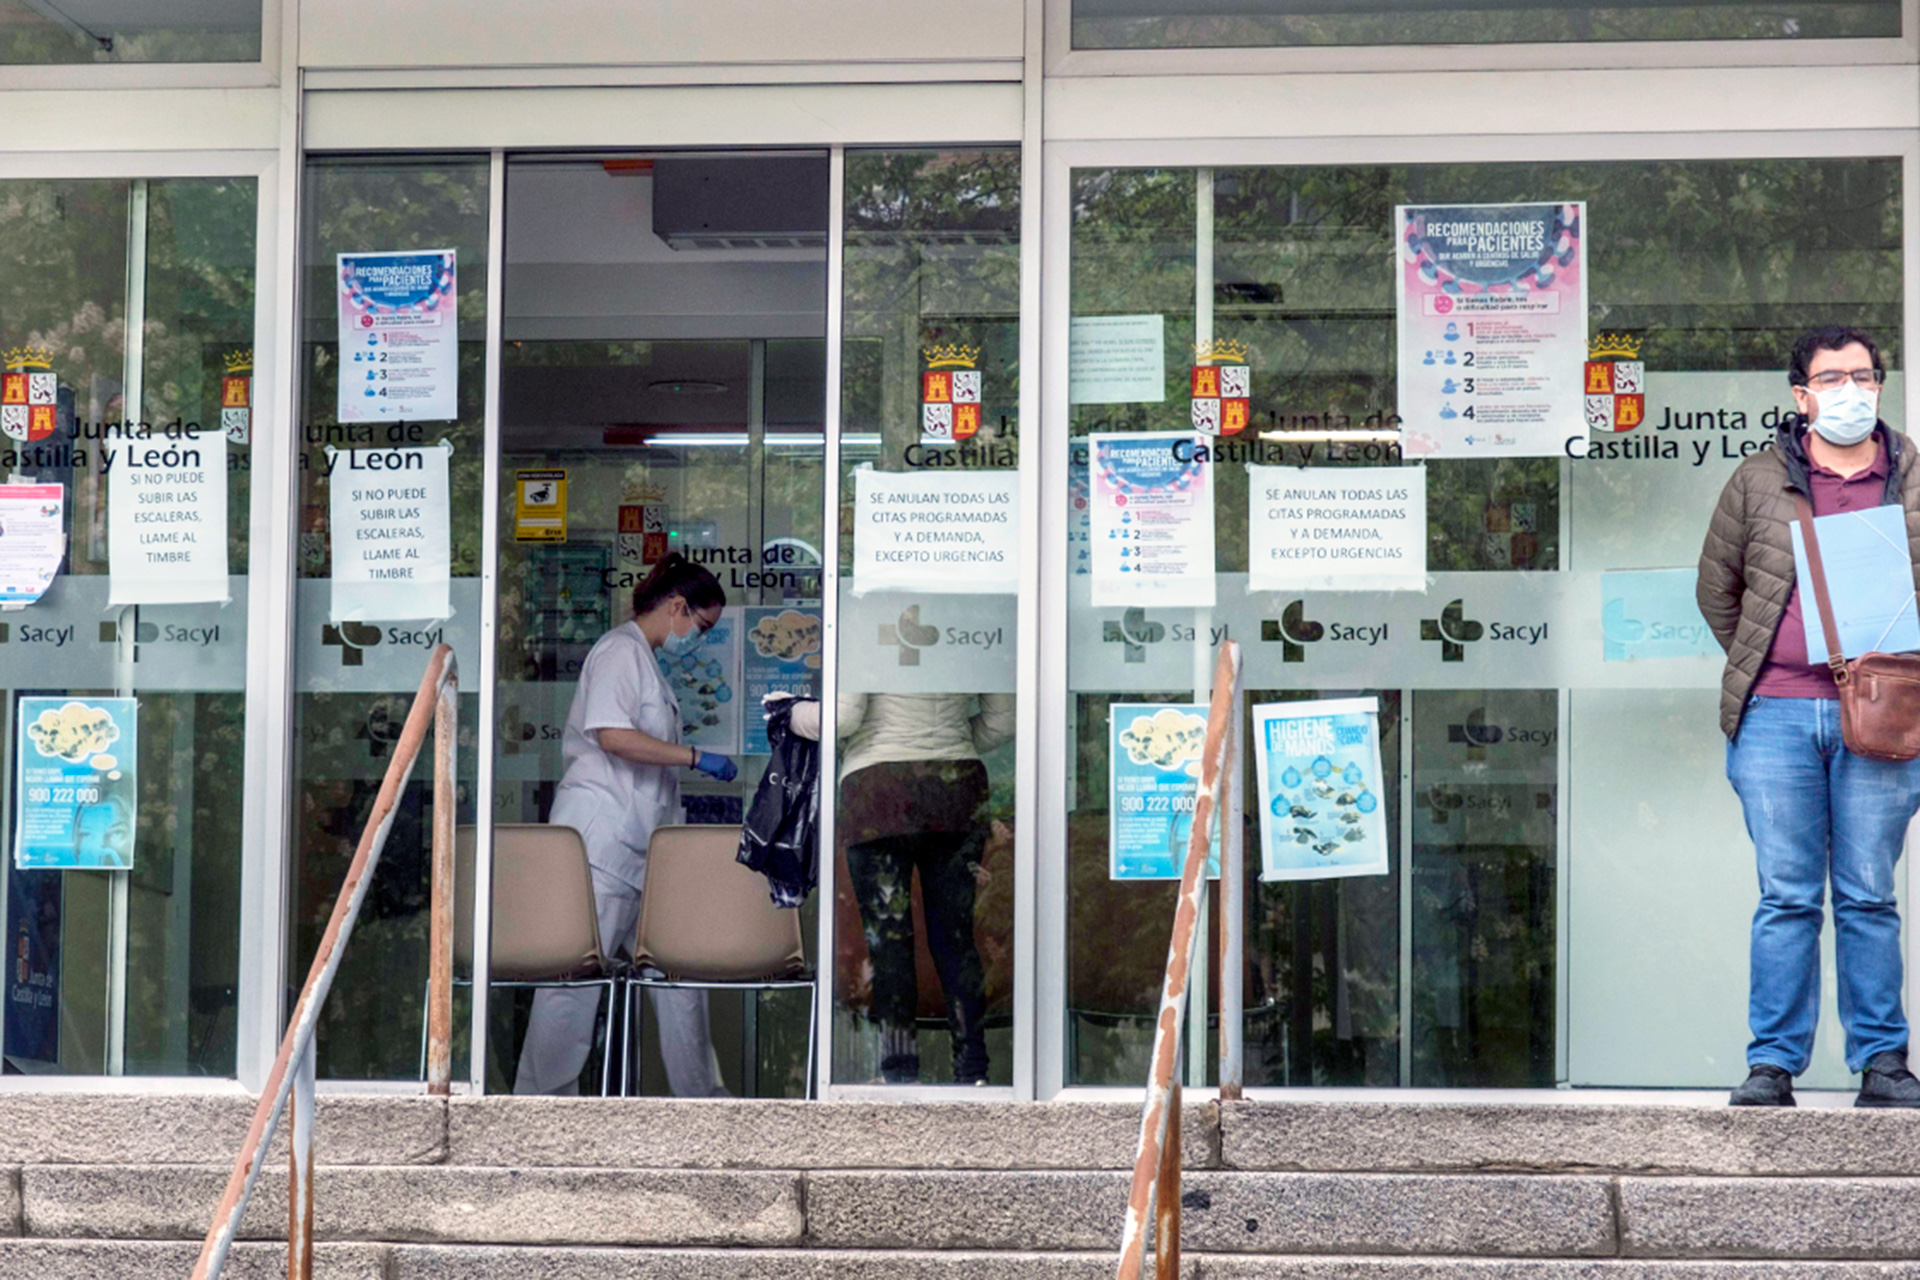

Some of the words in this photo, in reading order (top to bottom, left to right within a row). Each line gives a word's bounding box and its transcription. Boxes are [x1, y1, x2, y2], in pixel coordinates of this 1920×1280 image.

[1427, 221, 1545, 237] RECOMENDACIONES
[1446, 237, 1469, 247] PARA
[1468, 235, 1545, 252] PACIENTES
[1467, 322, 1474, 337] 1
[382, 332, 388, 343] 1
[379, 352, 388, 363] 2
[1463, 352, 1475, 367] 2
[379, 369, 388, 380] 3
[378, 387, 387, 397] 4
[1464, 377, 1475, 393] 3
[1462, 405, 1475, 420] 4
[1656, 407, 1747, 430] Junta
[67, 417, 152, 440] Junta
[164, 417, 201, 440] de
[300, 423, 374, 443] unta
[386, 420, 424, 443] de
[0, 446, 87, 468] astilla
[99, 450, 117, 474] y
[127, 443, 201, 468] León
[903, 443, 1016, 468] Castilla
[1171, 438, 1284, 463] Castilla
[1299, 446, 1315, 469] y
[1326, 437, 1403, 463] León
[1565, 435, 1680, 459] Castilla
[1692, 440, 1711, 467] y
[322, 452, 339, 478] y
[350, 446, 424, 470] León
[130, 473, 141, 485] SI
[144, 473, 163, 485] NO
[165, 471, 205, 484] PUEDE
[137, 492, 174, 504] SUBIR
[176, 491, 198, 503] LAS
[351, 489, 363, 501] SI
[365, 489, 385, 501] NO
[387, 487, 427, 500] PUEDE
[870, 492, 884, 504] SE
[887, 493, 940, 504] ANULAN
[942, 493, 986, 504] TODAS
[988, 492, 1010, 504] LAS
[1265, 488, 1280, 501] SE
[1283, 489, 1337, 501] ANULAN
[1340, 489, 1383, 501] TODAS
[1386, 488, 1409, 501] LAS
[134, 510, 203, 523] ESCALERAS,
[360, 508, 397, 520] SUBIR
[398, 508, 421, 519] LAS
[871, 511, 907, 523] CITAS
[909, 511, 1008, 523] PROGRAMADAS
[1268, 508, 1304, 520] CITAS
[1306, 508, 1407, 520] PROGRAMADAS
[139, 532, 179, 545] LLAME
[182, 532, 197, 543] AL
[356, 527, 425, 541] ESCALERAS,
[894, 531, 902, 543] Y
[904, 531, 914, 543] A
[916, 531, 985, 544] DEMANDA,
[1133, 529, 1141, 540] 2
[1290, 528, 1298, 539] Y
[1301, 528, 1310, 539] A
[1313, 528, 1383, 541] DEMANDA,
[145, 550, 192, 563] TIMBRE
[363, 548, 401, 561] LLAME
[404, 548, 420, 559] AL
[682, 544, 752, 564] Junta
[763, 544, 795, 564] de
[875, 550, 931, 562] EXCEPTO
[933, 550, 1005, 562] URGENCIAS
[1133, 546, 1141, 557] 3
[1271, 547, 1328, 559] EXCEPTO
[1330, 547, 1403, 559] URGENCIAS
[368, 567, 414, 580] TIMBRE
[1133, 563, 1142, 573] 4
[731, 567, 796, 588] León
[19, 624, 74, 647] Sacyl
[164, 623, 220, 646] Sacyl
[388, 627, 443, 650] Sacyl
[945, 627, 1002, 651] Sacyl
[1171, 623, 1229, 647] Sayl
[1329, 622, 1388, 646] Sacyl
[1489, 622, 1548, 645] Sacyl
[1650, 621, 1708, 645] Sacyl
[1269, 717, 1335, 741] HIGIENE
[1284, 738, 1336, 757] MANOS
[28, 788, 51, 803] 900
[52, 788, 75, 803] 222
[76, 788, 99, 803] 000
[1121, 796, 1145, 812] 900
[1146, 796, 1169, 812] 222
[1171, 796, 1195, 812] 000
